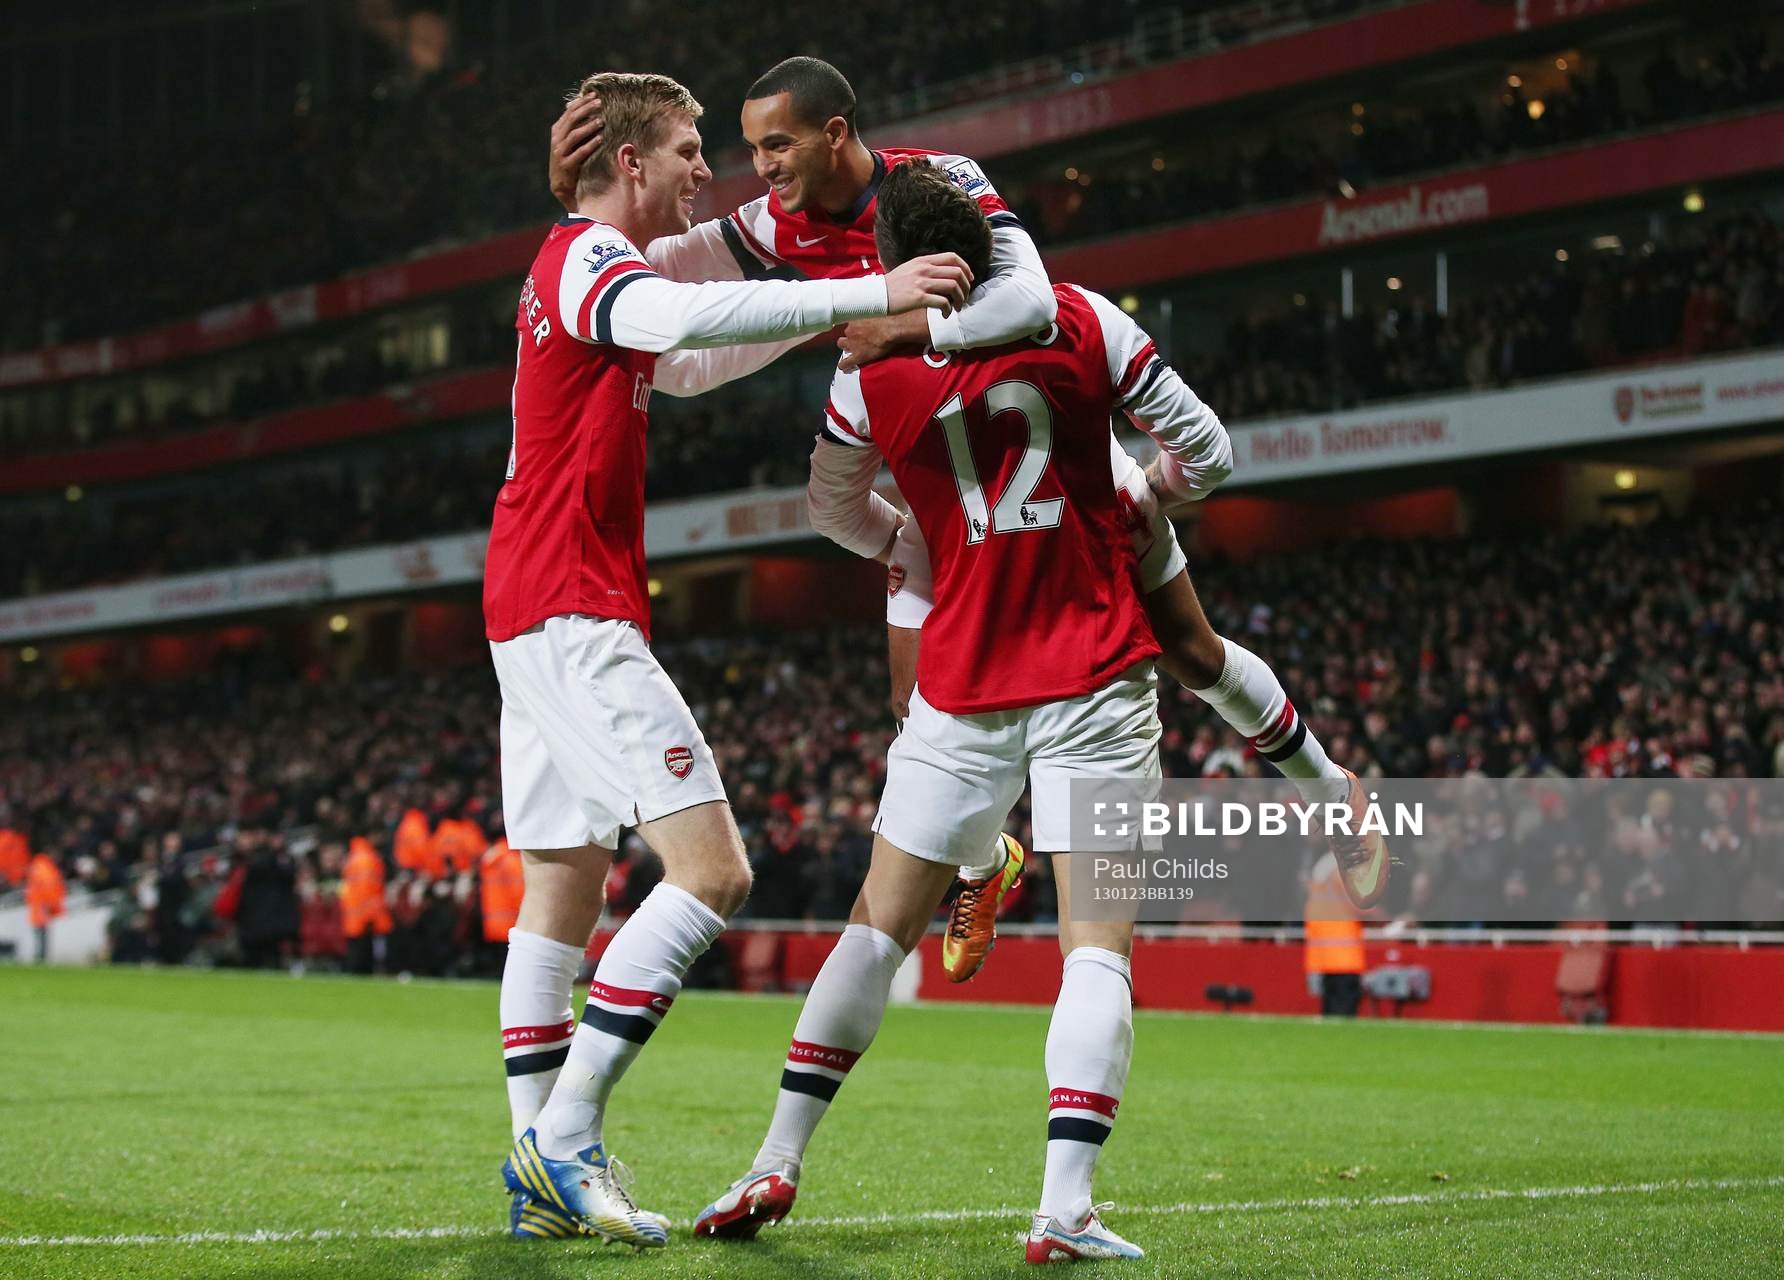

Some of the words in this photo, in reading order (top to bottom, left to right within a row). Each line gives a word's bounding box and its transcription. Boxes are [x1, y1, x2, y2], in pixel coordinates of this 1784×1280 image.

[1318, 185, 1489, 246] Arsenal.com
[933, 379, 1066, 546] 12
[1251, 426, 1315, 464] Hello
